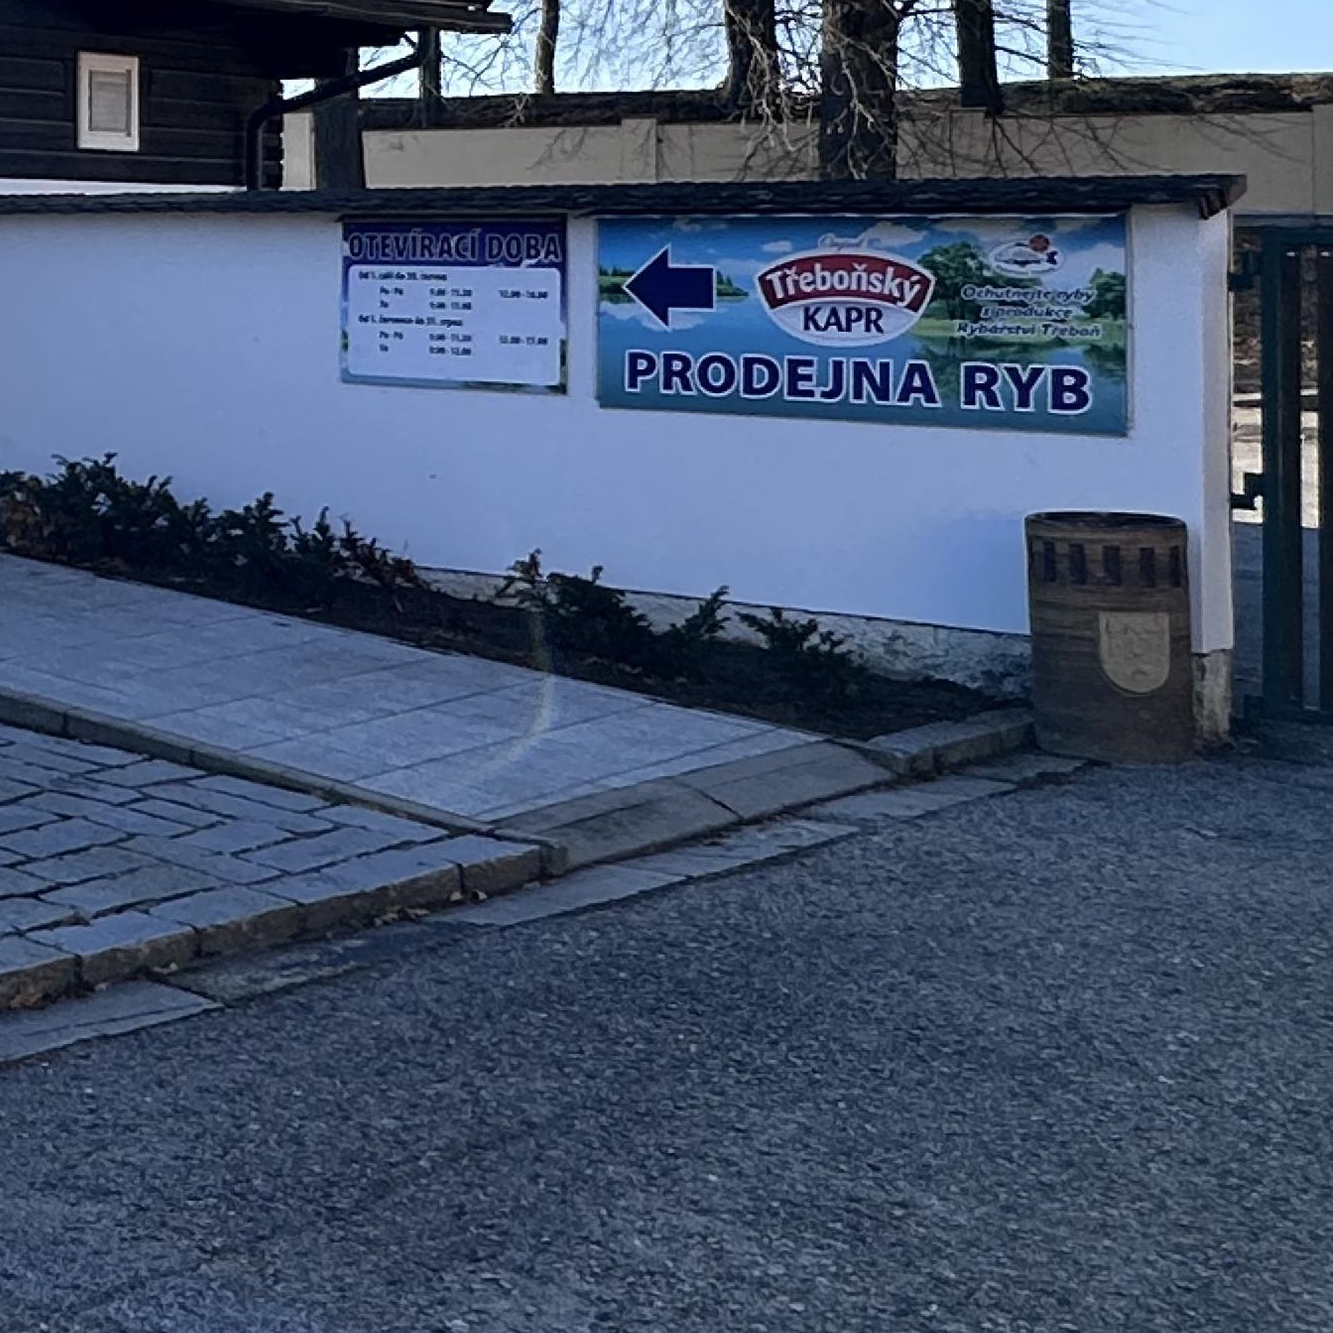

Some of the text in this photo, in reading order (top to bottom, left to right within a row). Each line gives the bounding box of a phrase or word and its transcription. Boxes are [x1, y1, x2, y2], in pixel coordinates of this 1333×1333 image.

[348, 228, 562, 262] OTEVÍRACÍ DOBA
[766, 262, 921, 307] Třeboňský
[803, 306, 884, 335] KAPR
[625, 349, 1092, 416] PRODEJNA RYB
